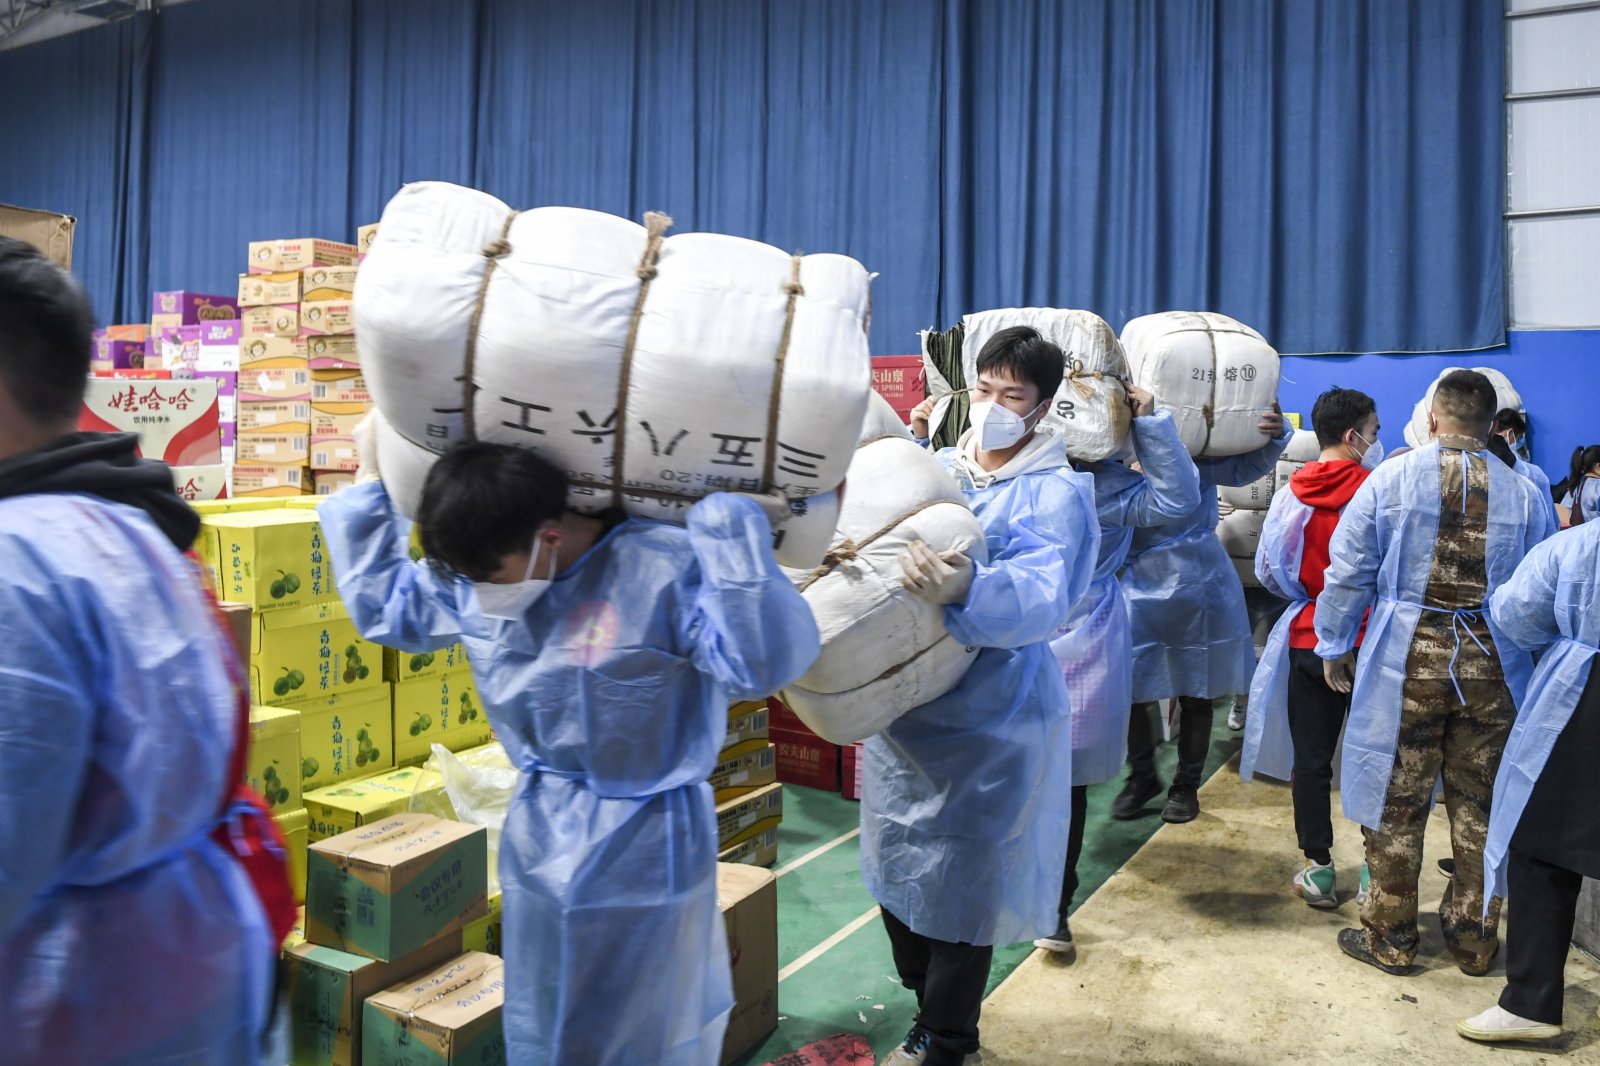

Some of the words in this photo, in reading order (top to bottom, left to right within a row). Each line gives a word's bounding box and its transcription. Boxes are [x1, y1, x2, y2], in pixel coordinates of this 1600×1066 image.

[881, 384, 904, 392] SPRING
[107, 384, 194, 412] 娃哈哈
[1056, 401, 1076, 420] 50
[133, 415, 171, 424] 饮用纯净水
